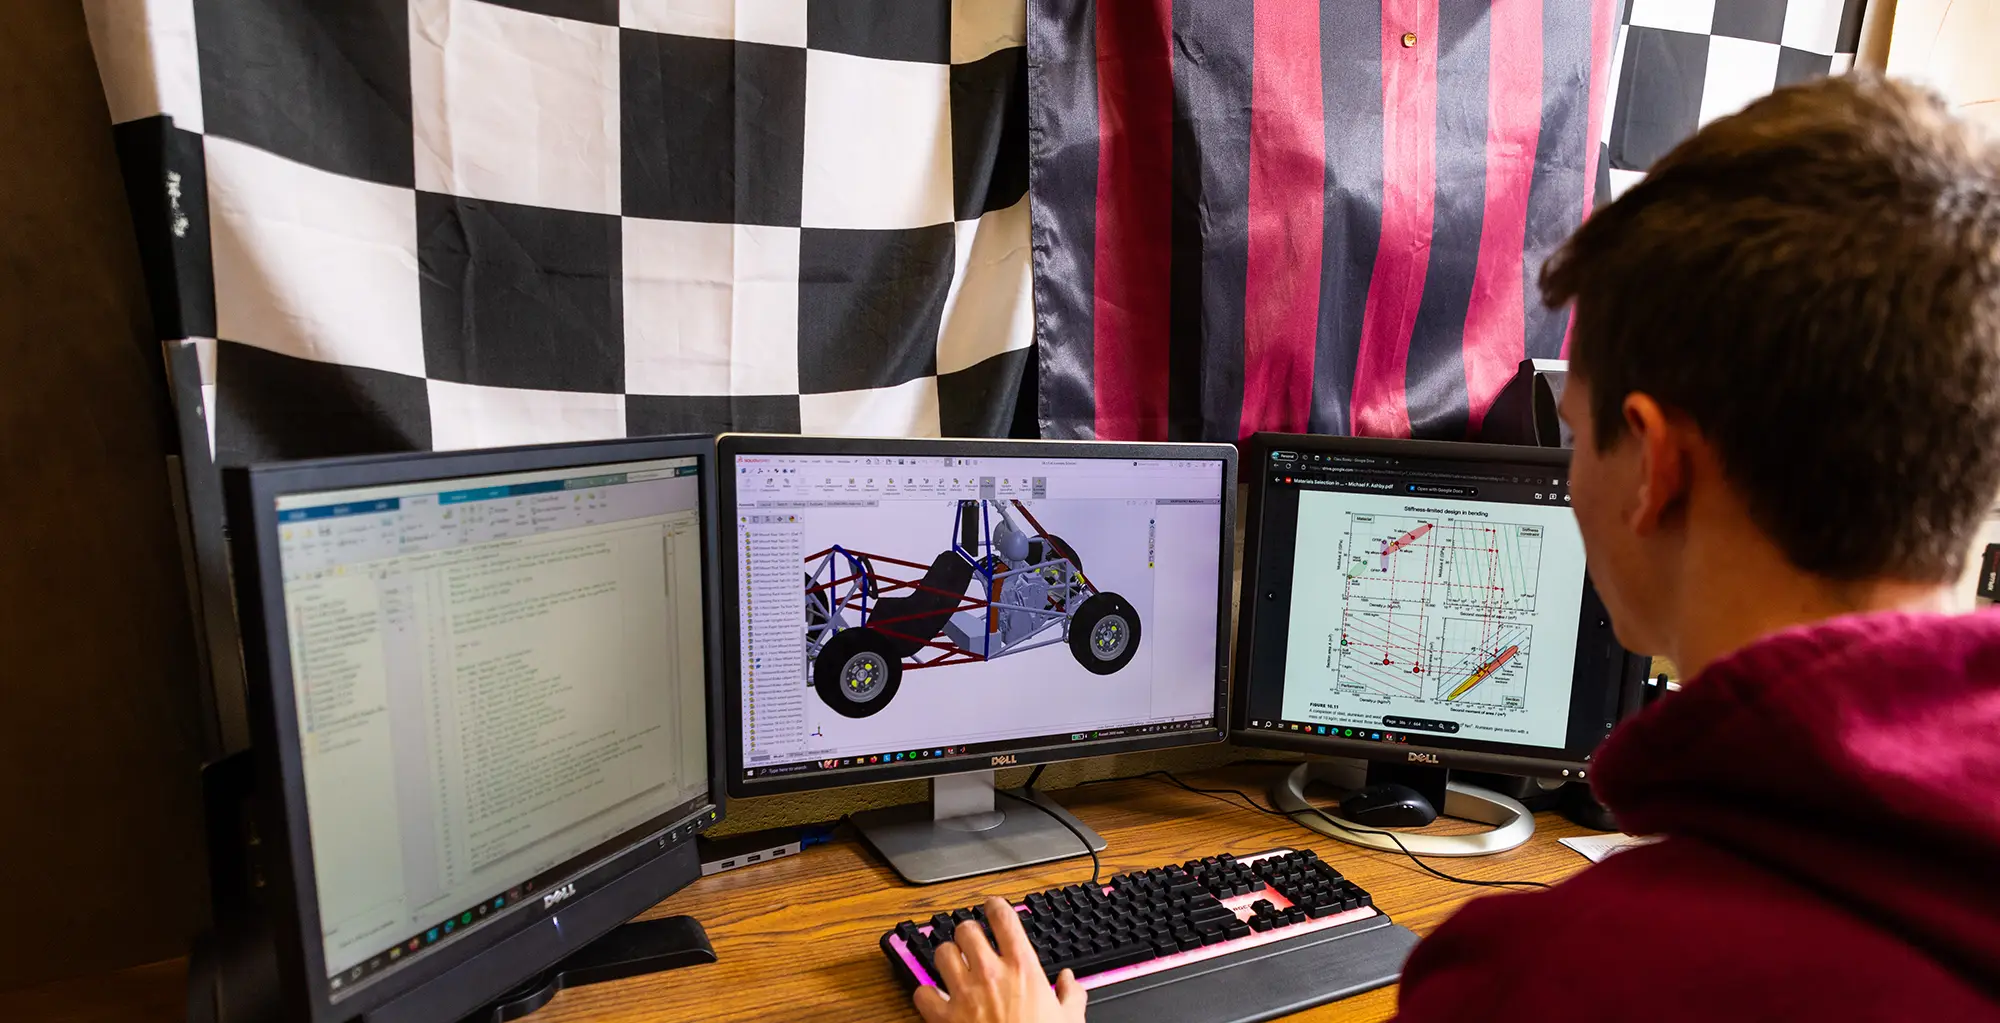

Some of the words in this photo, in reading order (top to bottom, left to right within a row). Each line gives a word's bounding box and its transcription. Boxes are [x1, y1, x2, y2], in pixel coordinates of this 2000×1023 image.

[1404, 506, 1443, 514] Stiffness-limited
[992, 755, 1017, 766] DELL
[1408, 752, 1439, 763] DELL
[544, 884, 576, 910] DELL
